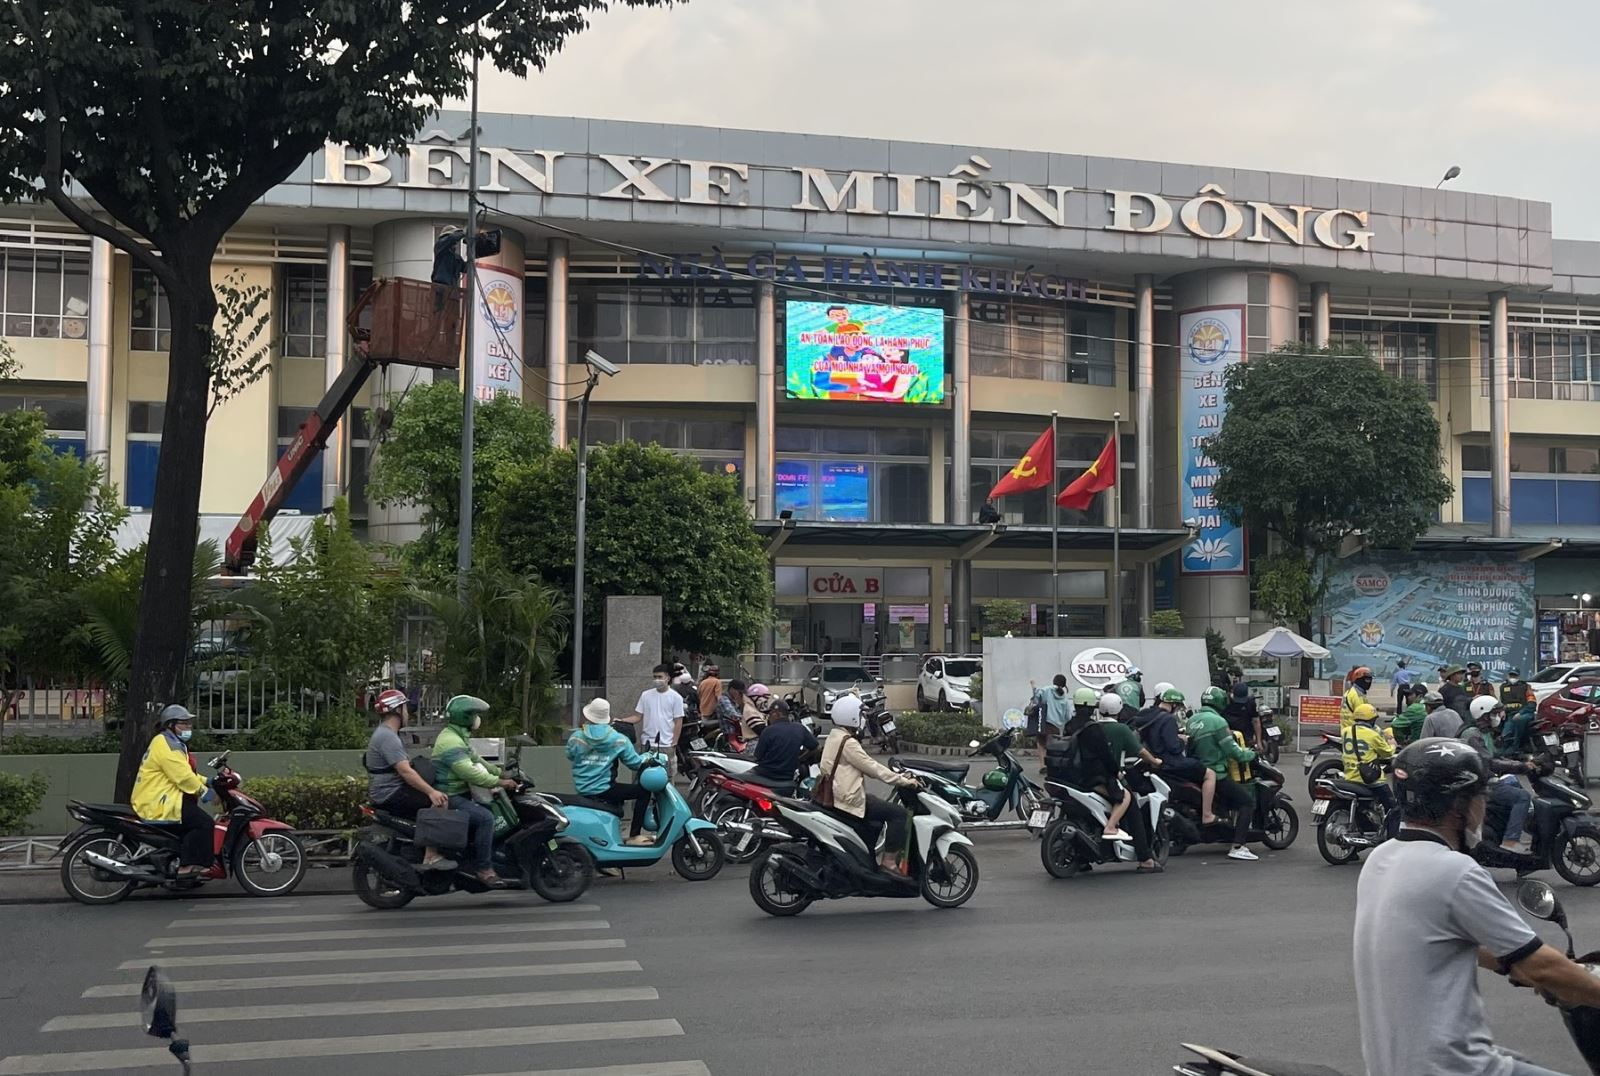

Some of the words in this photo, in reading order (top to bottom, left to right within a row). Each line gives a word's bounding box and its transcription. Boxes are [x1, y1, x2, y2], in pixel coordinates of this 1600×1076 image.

[599, 154, 749, 206] XE
[791, 155, 1074, 226] MIỀN
[1104, 184, 1374, 251] ĐÔNG
[637, 245, 733, 280] NHÀ
[746, 250, 808, 282] GA
[821, 252, 945, 290] HÀNH
[957, 264, 1089, 301] KHÁCH
[488, 362, 512, 382] KẾT
[1194, 371, 1223, 389] BẾN
[1199, 394, 1218, 408] XE
[1198, 414, 1219, 428] AN
[1190, 474, 1221, 489] MIN
[813, 572, 857, 594] CỬA
[864, 577, 880, 594] B
[1356, 578, 1389, 588] SAMCO
[1470, 646, 1486, 656] GIA
[1488, 646, 1503, 656] LAI
[1077, 663, 1127, 674] SAMCO
